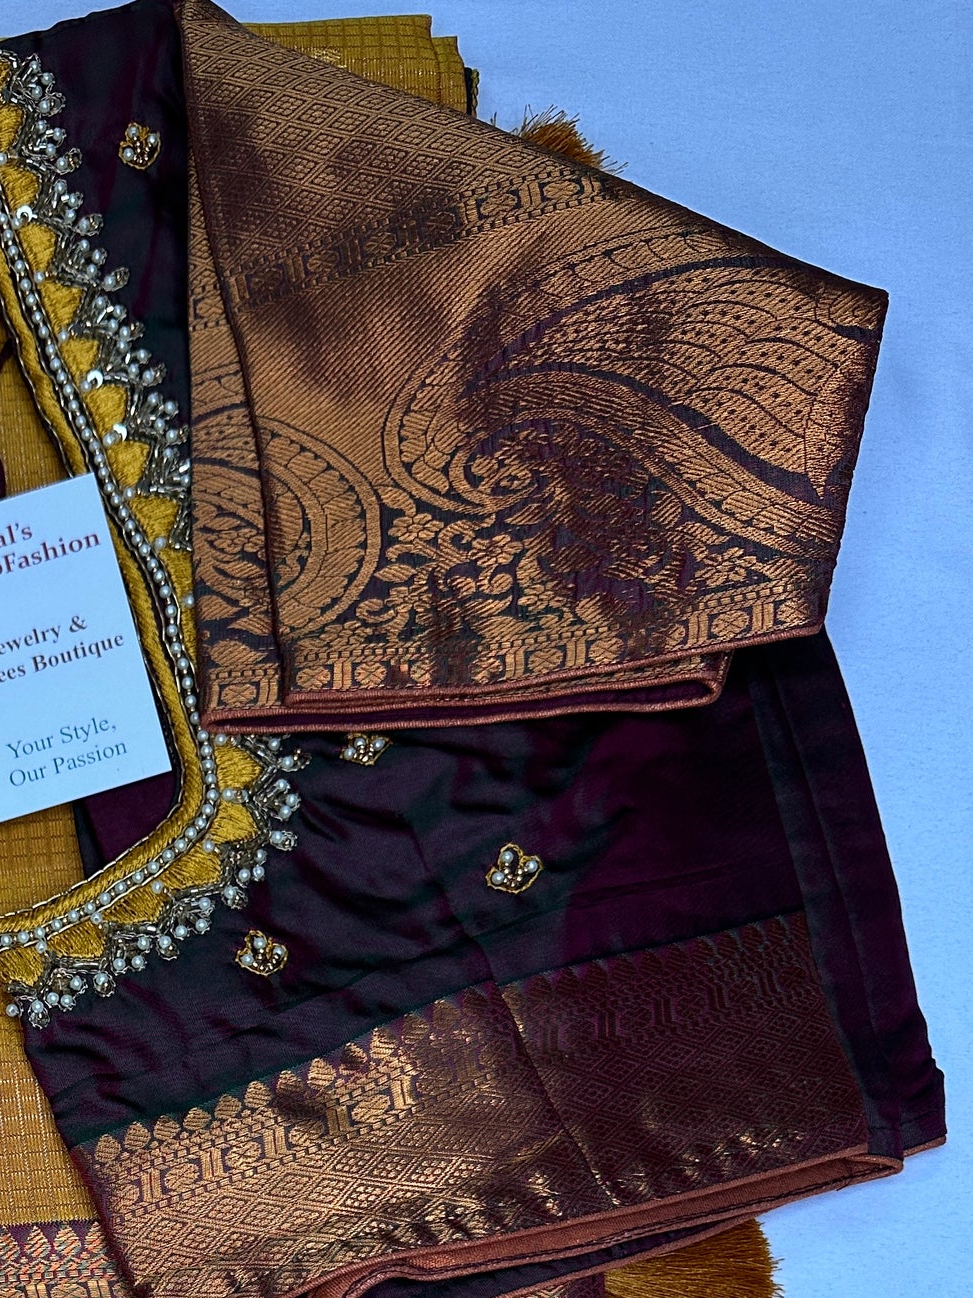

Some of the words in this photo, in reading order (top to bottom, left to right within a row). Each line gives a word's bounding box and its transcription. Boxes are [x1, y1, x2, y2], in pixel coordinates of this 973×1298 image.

[68, 614, 87, 634] &
[31, 634, 125, 673] Boutique
[6, 735, 53, 760] Your
[9, 765, 46, 787] Our
[53, 743, 127, 775] Passion
